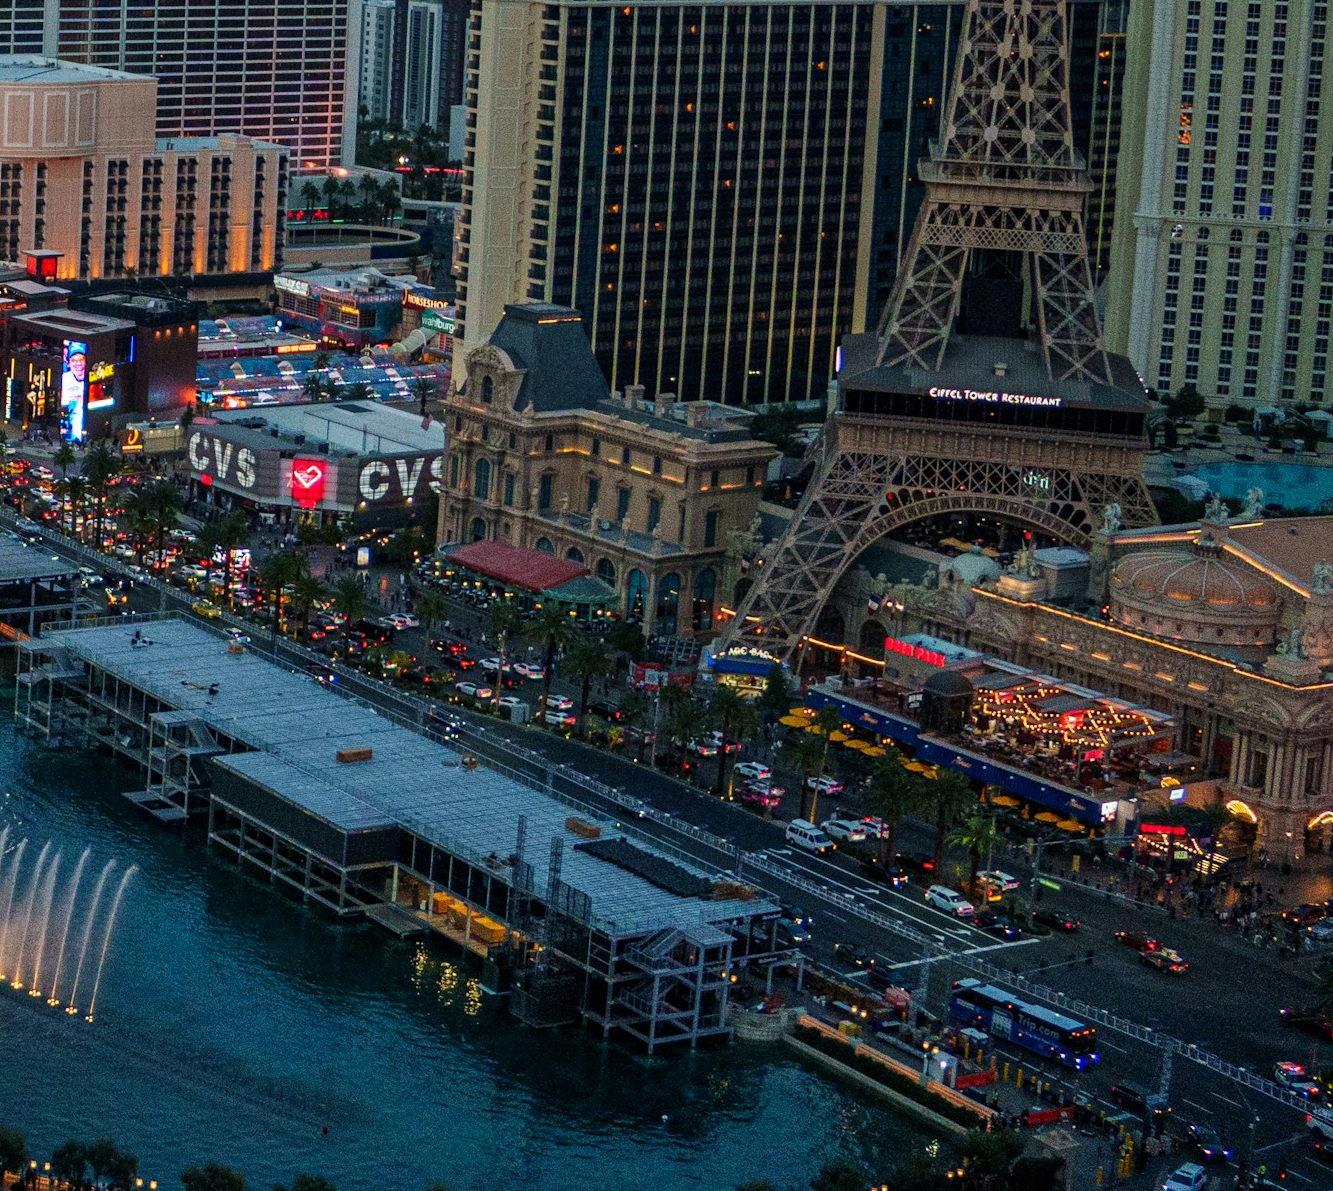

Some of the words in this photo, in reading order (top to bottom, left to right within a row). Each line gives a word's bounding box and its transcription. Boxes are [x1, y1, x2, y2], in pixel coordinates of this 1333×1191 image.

[929, 387, 962, 400] EIFFEL
[963, 389, 998, 402] TOWER
[1001, 393, 1062, 407] RESTAURANT
[188, 431, 256, 489] CVS
[885, 637, 914, 657] BEER
[914, 646, 946, 668] PARK
[1017, 1013, 1060, 1039] Trip.com
